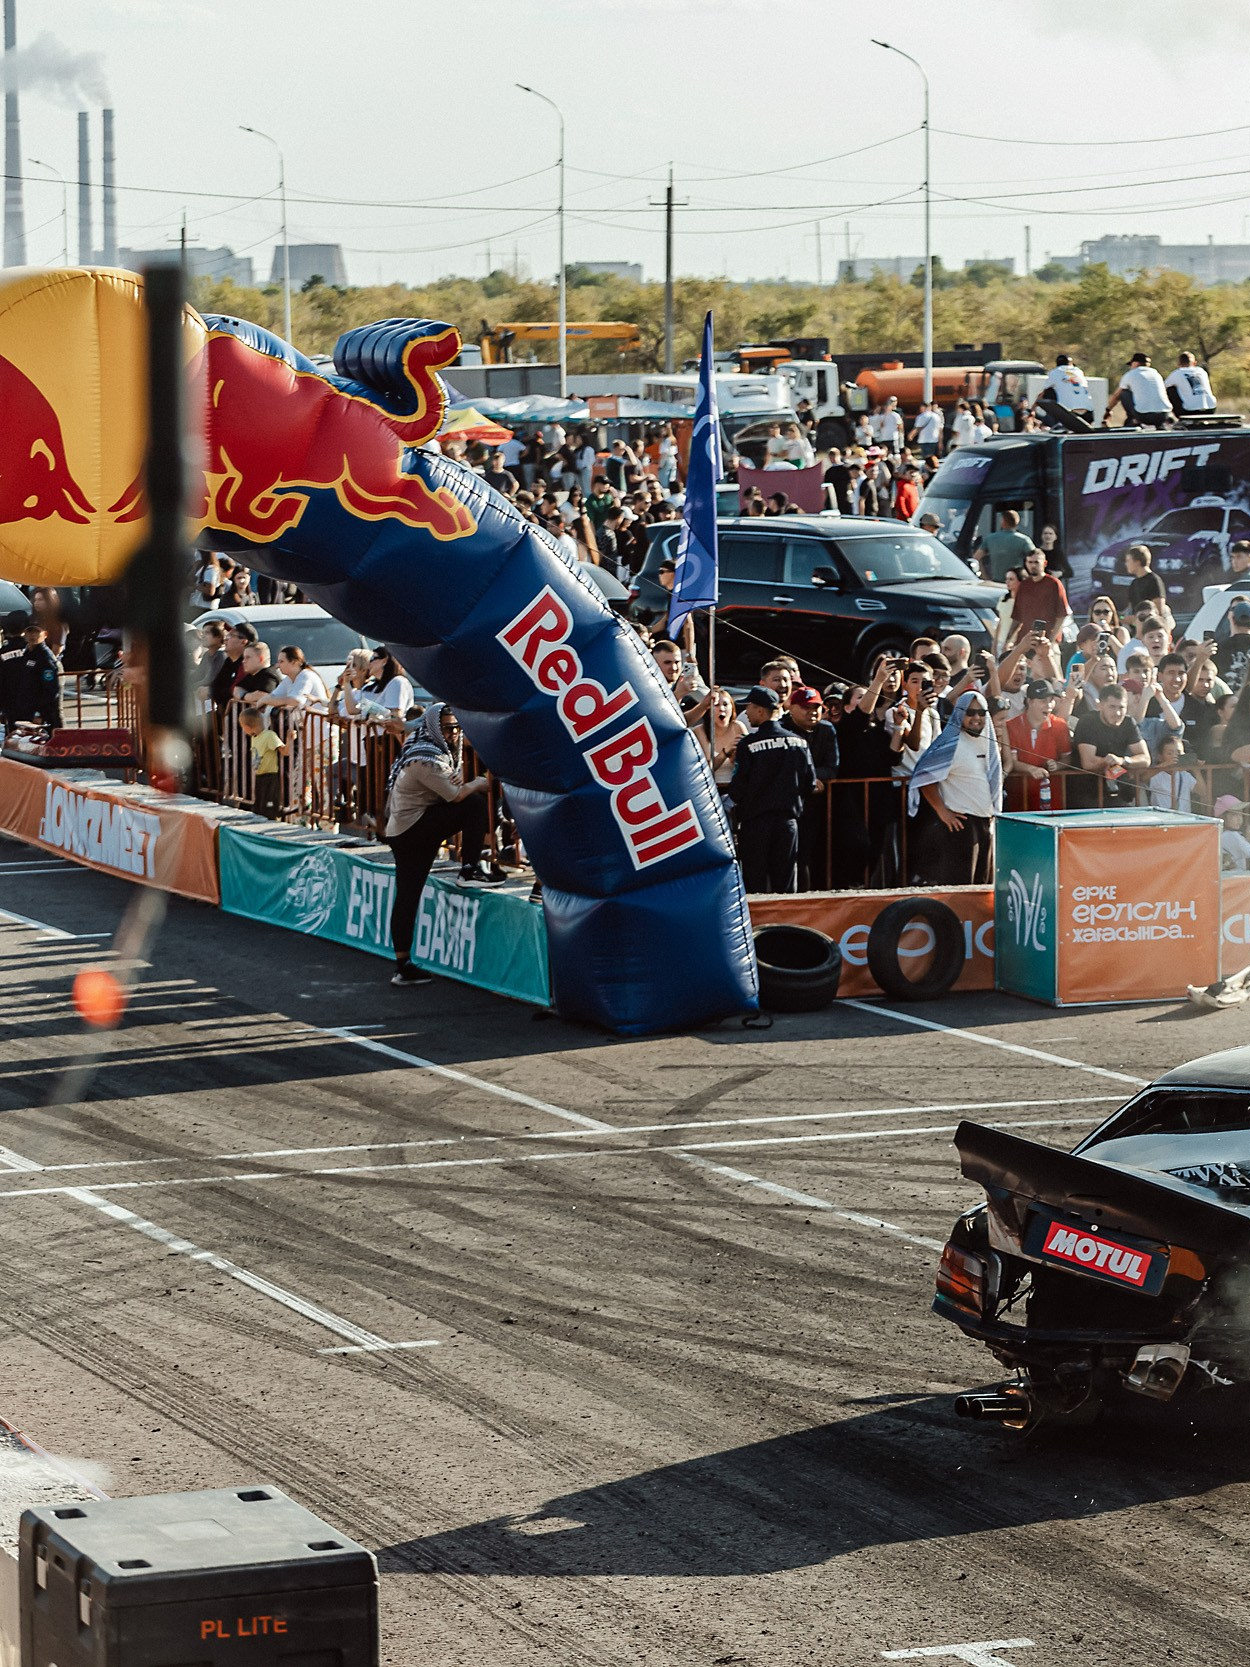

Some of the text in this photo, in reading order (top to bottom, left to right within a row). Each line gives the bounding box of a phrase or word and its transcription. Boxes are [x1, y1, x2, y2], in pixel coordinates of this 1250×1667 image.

[1082, 443, 1221, 495] DRIFT
[496, 586, 639, 742] Red
[584, 717, 704, 869] Bull
[415, 885, 480, 973] БАЯН
[1048, 1228, 1142, 1280] MOTUL
[200, 1615, 288, 1640] PL LITE
